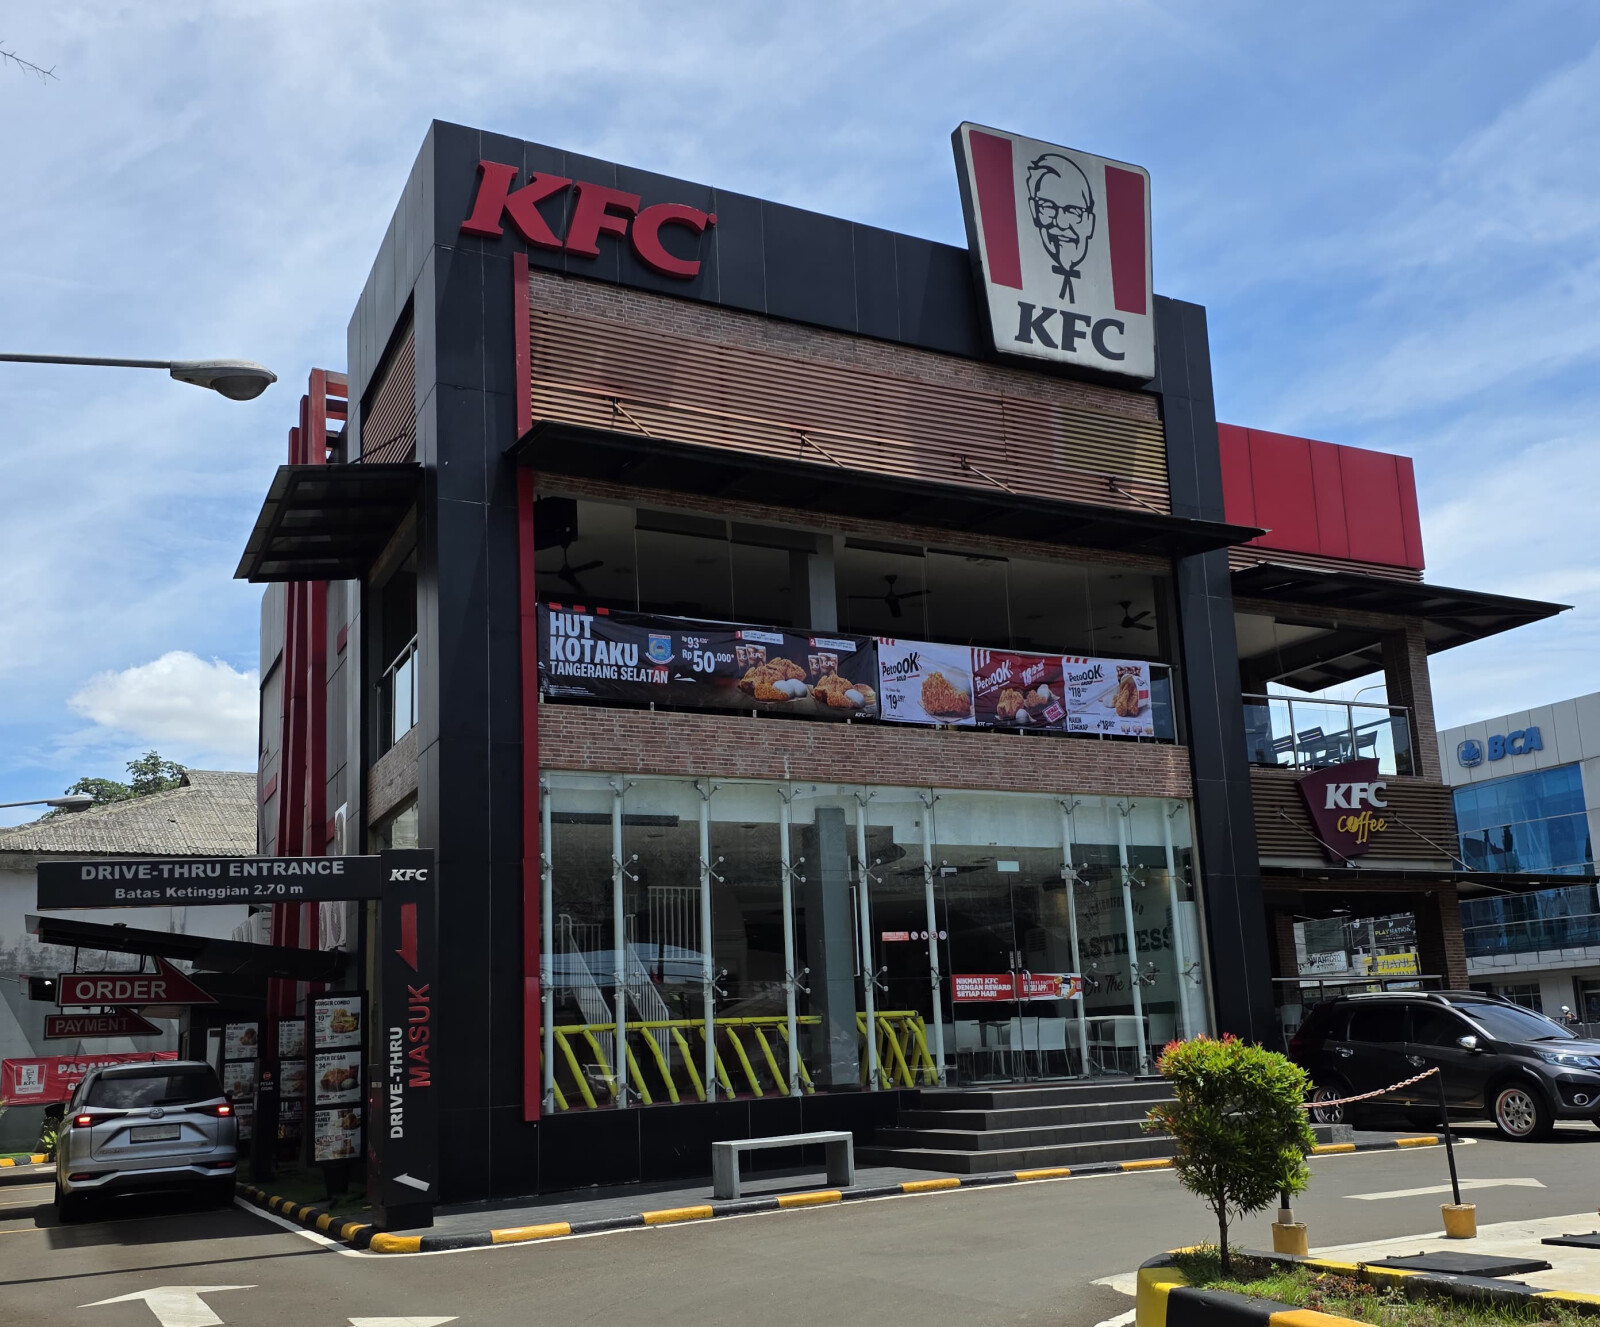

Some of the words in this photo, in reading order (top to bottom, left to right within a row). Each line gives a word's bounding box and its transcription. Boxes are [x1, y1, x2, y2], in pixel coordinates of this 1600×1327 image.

[461, 160, 709, 279] KFC
[1014, 301, 1125, 360] KFC
[549, 611, 594, 638] HUT
[549, 636, 639, 667] KOTAKU
[682, 650, 693, 660] Rp
[549, 661, 618, 681] TANGERANG
[620, 667, 669, 684] SELATAN
[1488, 726, 1543, 762] BCA
[1324, 782, 1388, 809] KFC
[81, 862, 221, 881] DRIVE-THRU
[228, 860, 345, 877] ENTRANCE
[389, 868, 428, 882] KFC
[114, 888, 160, 900] Batas
[165, 885, 250, 900] Ketinggian
[253, 884, 286, 896] 2.70
[290, 884, 304, 895] m
[75, 980, 167, 1000] ORDER
[955, 977, 984, 985] NIKMATI
[1105, 974, 1125, 995] The
[957, 990, 980, 998] SETIAP
[55, 1017, 129, 1034] PAYMENT
[407, 984, 431, 1087] MASUK
[389, 1027, 403, 1138] DRIVE-THRU
